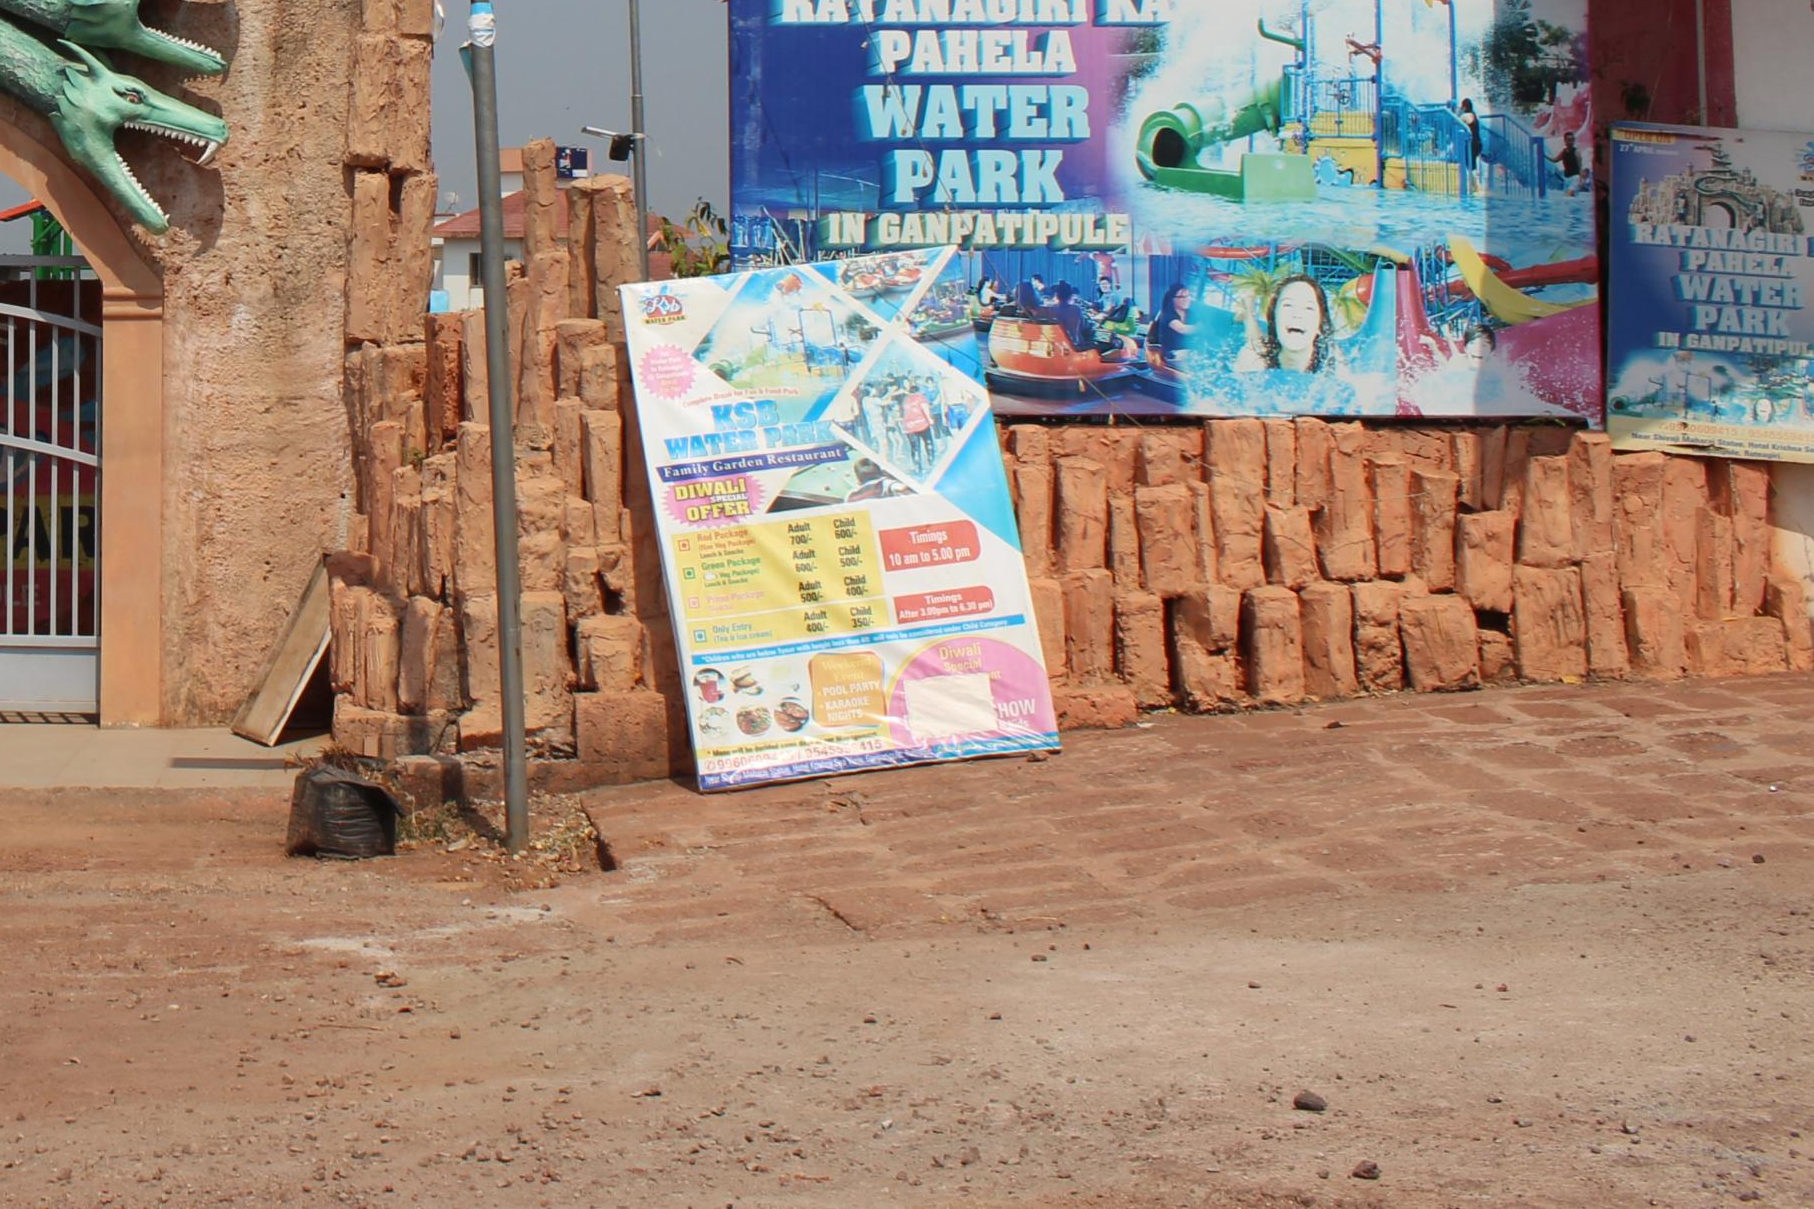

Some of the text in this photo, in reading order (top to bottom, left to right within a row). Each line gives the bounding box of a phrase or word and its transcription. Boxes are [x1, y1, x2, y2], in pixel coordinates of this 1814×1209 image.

[876, 29, 1078, 74] PAHELA
[860, 84, 1091, 139] WATER
[891, 149, 1065, 204] PARK
[826, 213, 1131, 246] IN GANPATIPULE
[1634, 224, 1804, 255] RATANAGIRI
[1687, 249, 1795, 278] PAHELA
[1678, 274, 1804, 309] WATER
[1694, 304, 1790, 337] PARK
[1657, 330, 1814, 357] IN GANPATIPUL
[711, 399, 780, 431] KSB
[664, 421, 837, 460] WATER PARK
[663, 448, 843, 478] Family Garden Restaurant
[674, 477, 747, 501] DIWALI
[710, 493, 748, 503] SPECIAL
[686, 501, 753, 522] OFFER
[714, 528, 749, 540] Package
[787, 517, 856, 533] Adult Child
[789, 528, 858, 545] 700/- 600/-
[908, 528, 949, 545] Timings
[793, 544, 861, 560] Adult Child
[889, 546, 971, 566] 10 am to 5.00 pm
[701, 556, 761, 571] Green Package
[795, 556, 863, 573] 600/- 500/-
[798, 574, 867, 592] Adult Child
[800, 585, 869, 603] 500/- 400/-
[924, 592, 963, 605] Timings
[804, 605, 873, 621] Adult Child
[899, 609, 919, 620] After
[920, 605, 949, 616] 3.00pm
[949, 605, 959, 613] to
[977, 599, 993, 611] pm)
[712, 622, 752, 635] Only Entry
[806, 617, 875, 633] 400/- 350/-
[938, 643, 982, 661] Diwali
[943, 658, 982, 672] Special
[822, 680, 881, 696] POOL PARTY
[824, 696, 871, 711] KARAOKE
[992, 698, 1036, 719] HOW
[827, 708, 864, 722] NIGHTS
